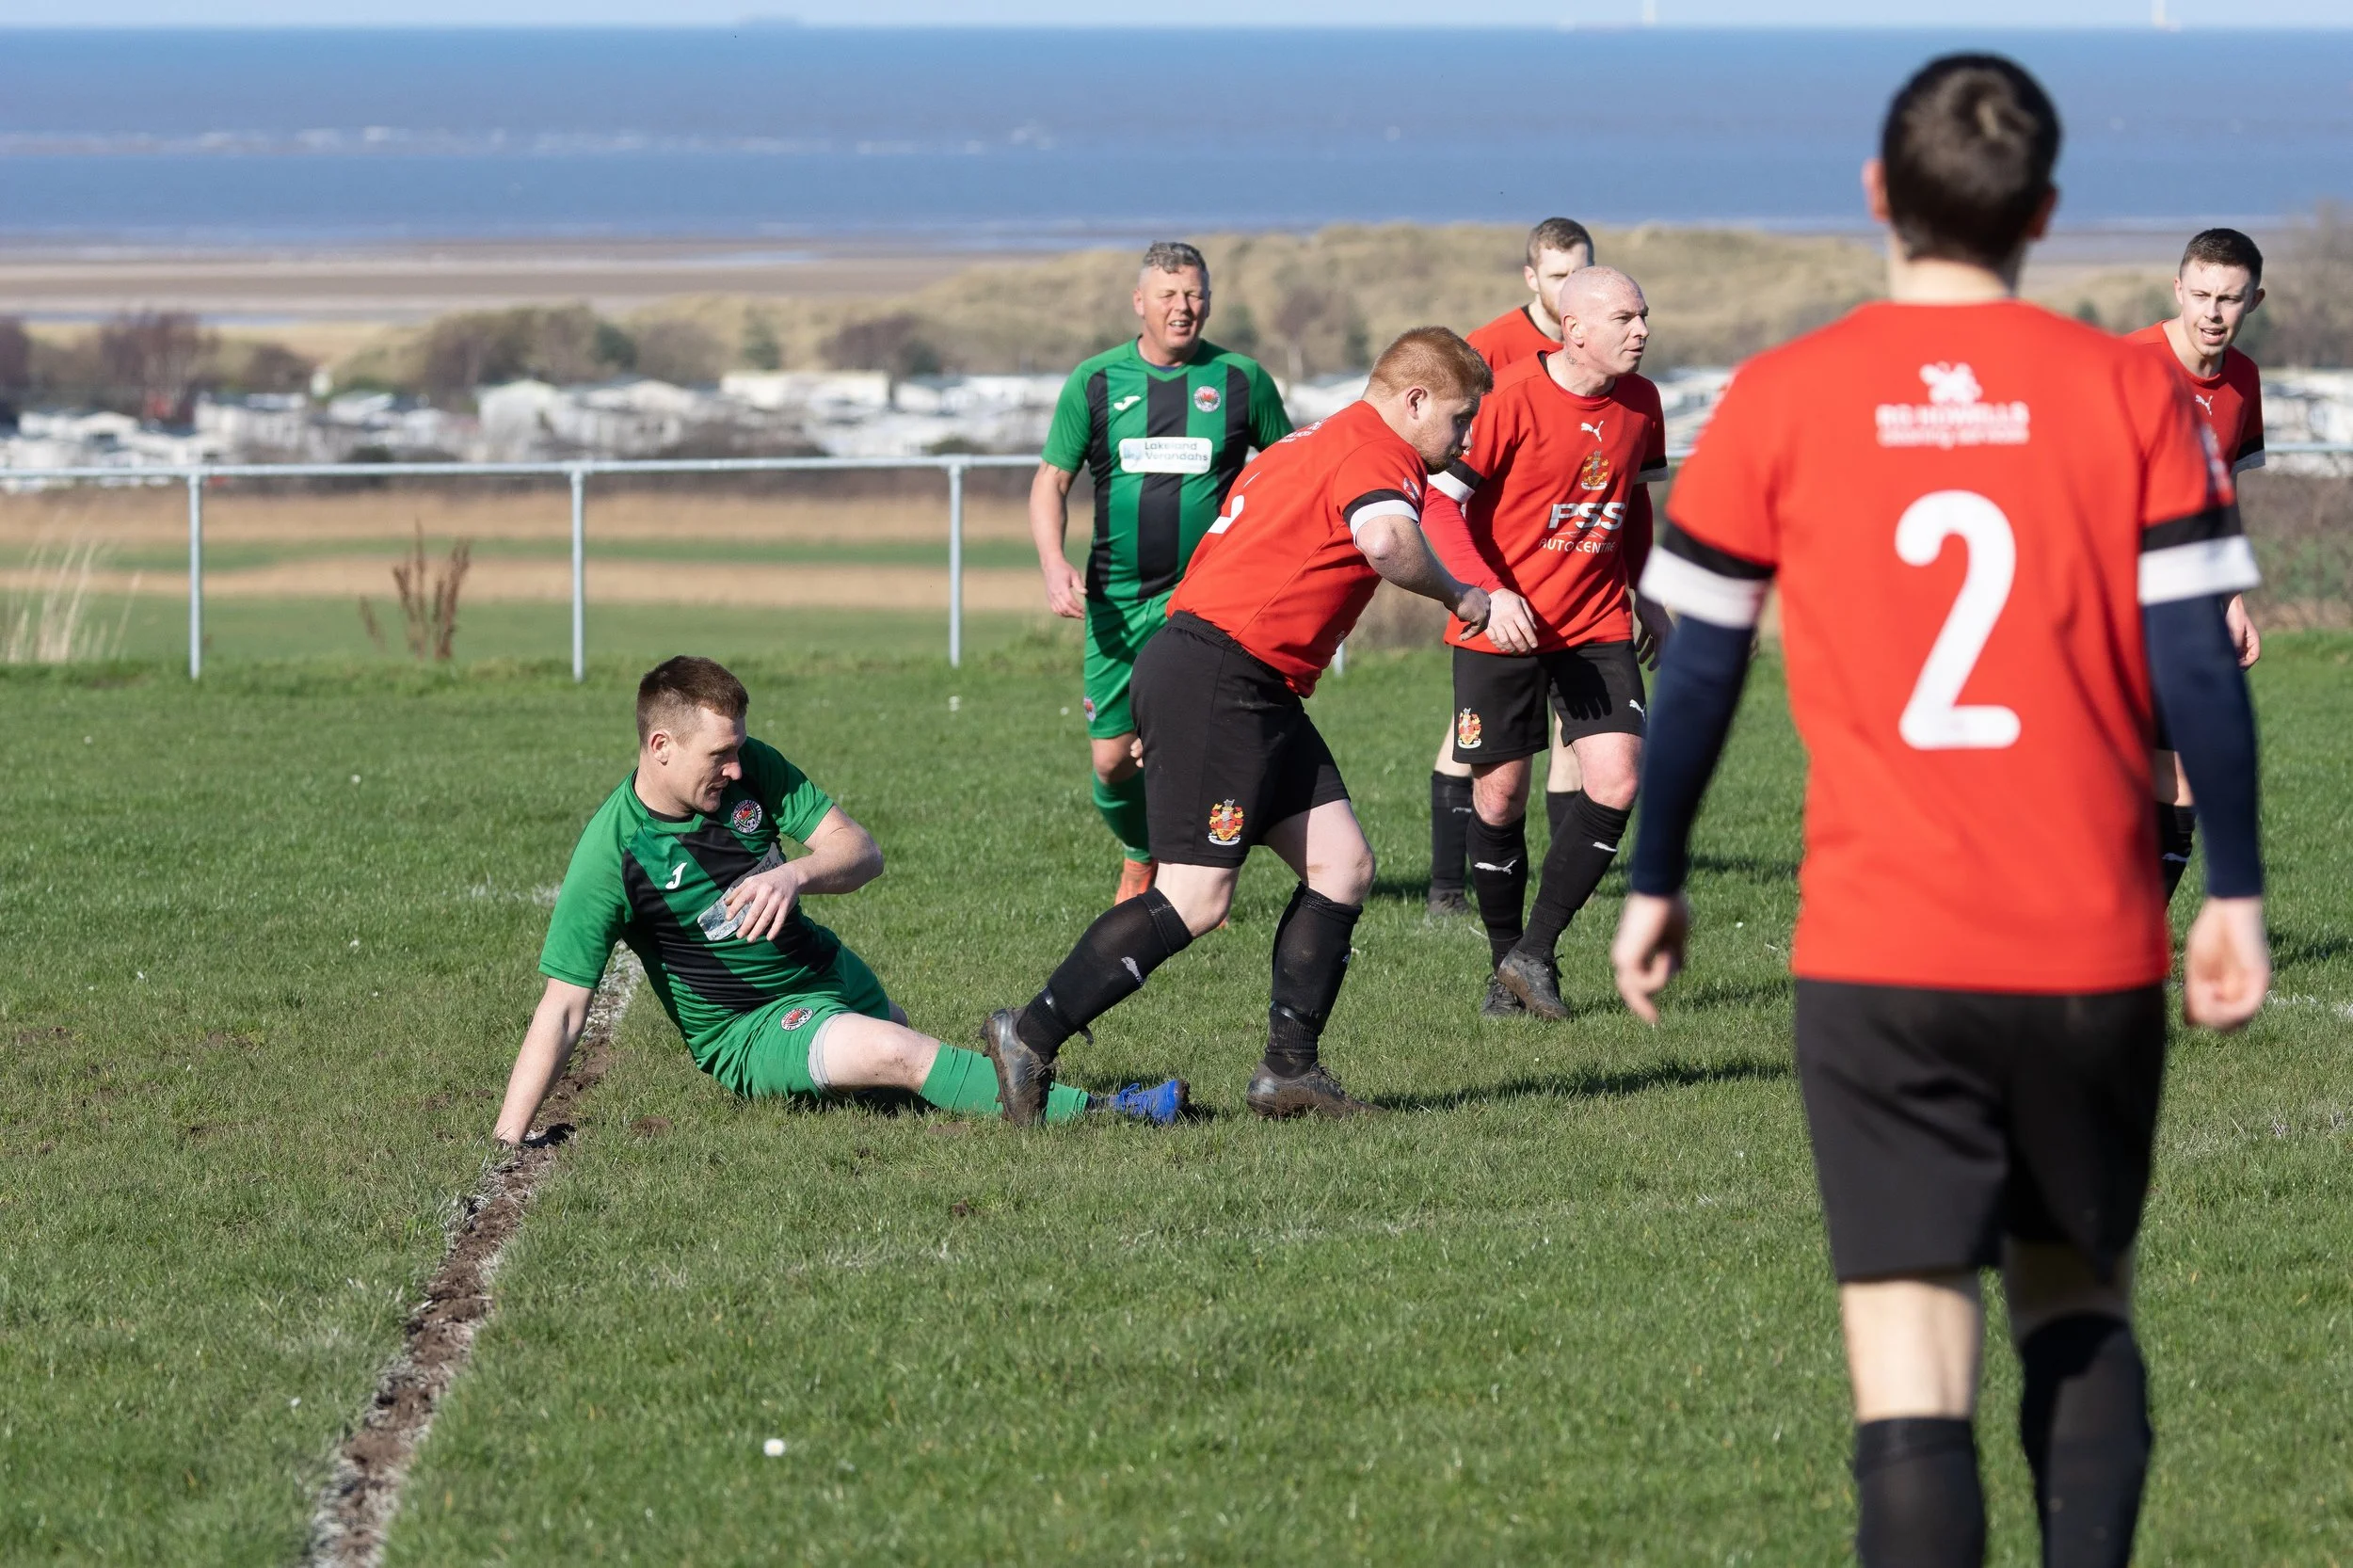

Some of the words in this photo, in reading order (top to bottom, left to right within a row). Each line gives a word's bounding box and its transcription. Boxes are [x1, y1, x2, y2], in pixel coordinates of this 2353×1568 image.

[1144, 441, 1198, 451] Lakeland
[1144, 452, 1209, 461] Verandahs
[1547, 502, 1625, 531] PSS
[1538, 537, 1575, 552] AUTO
[1894, 488, 2022, 751] 2
